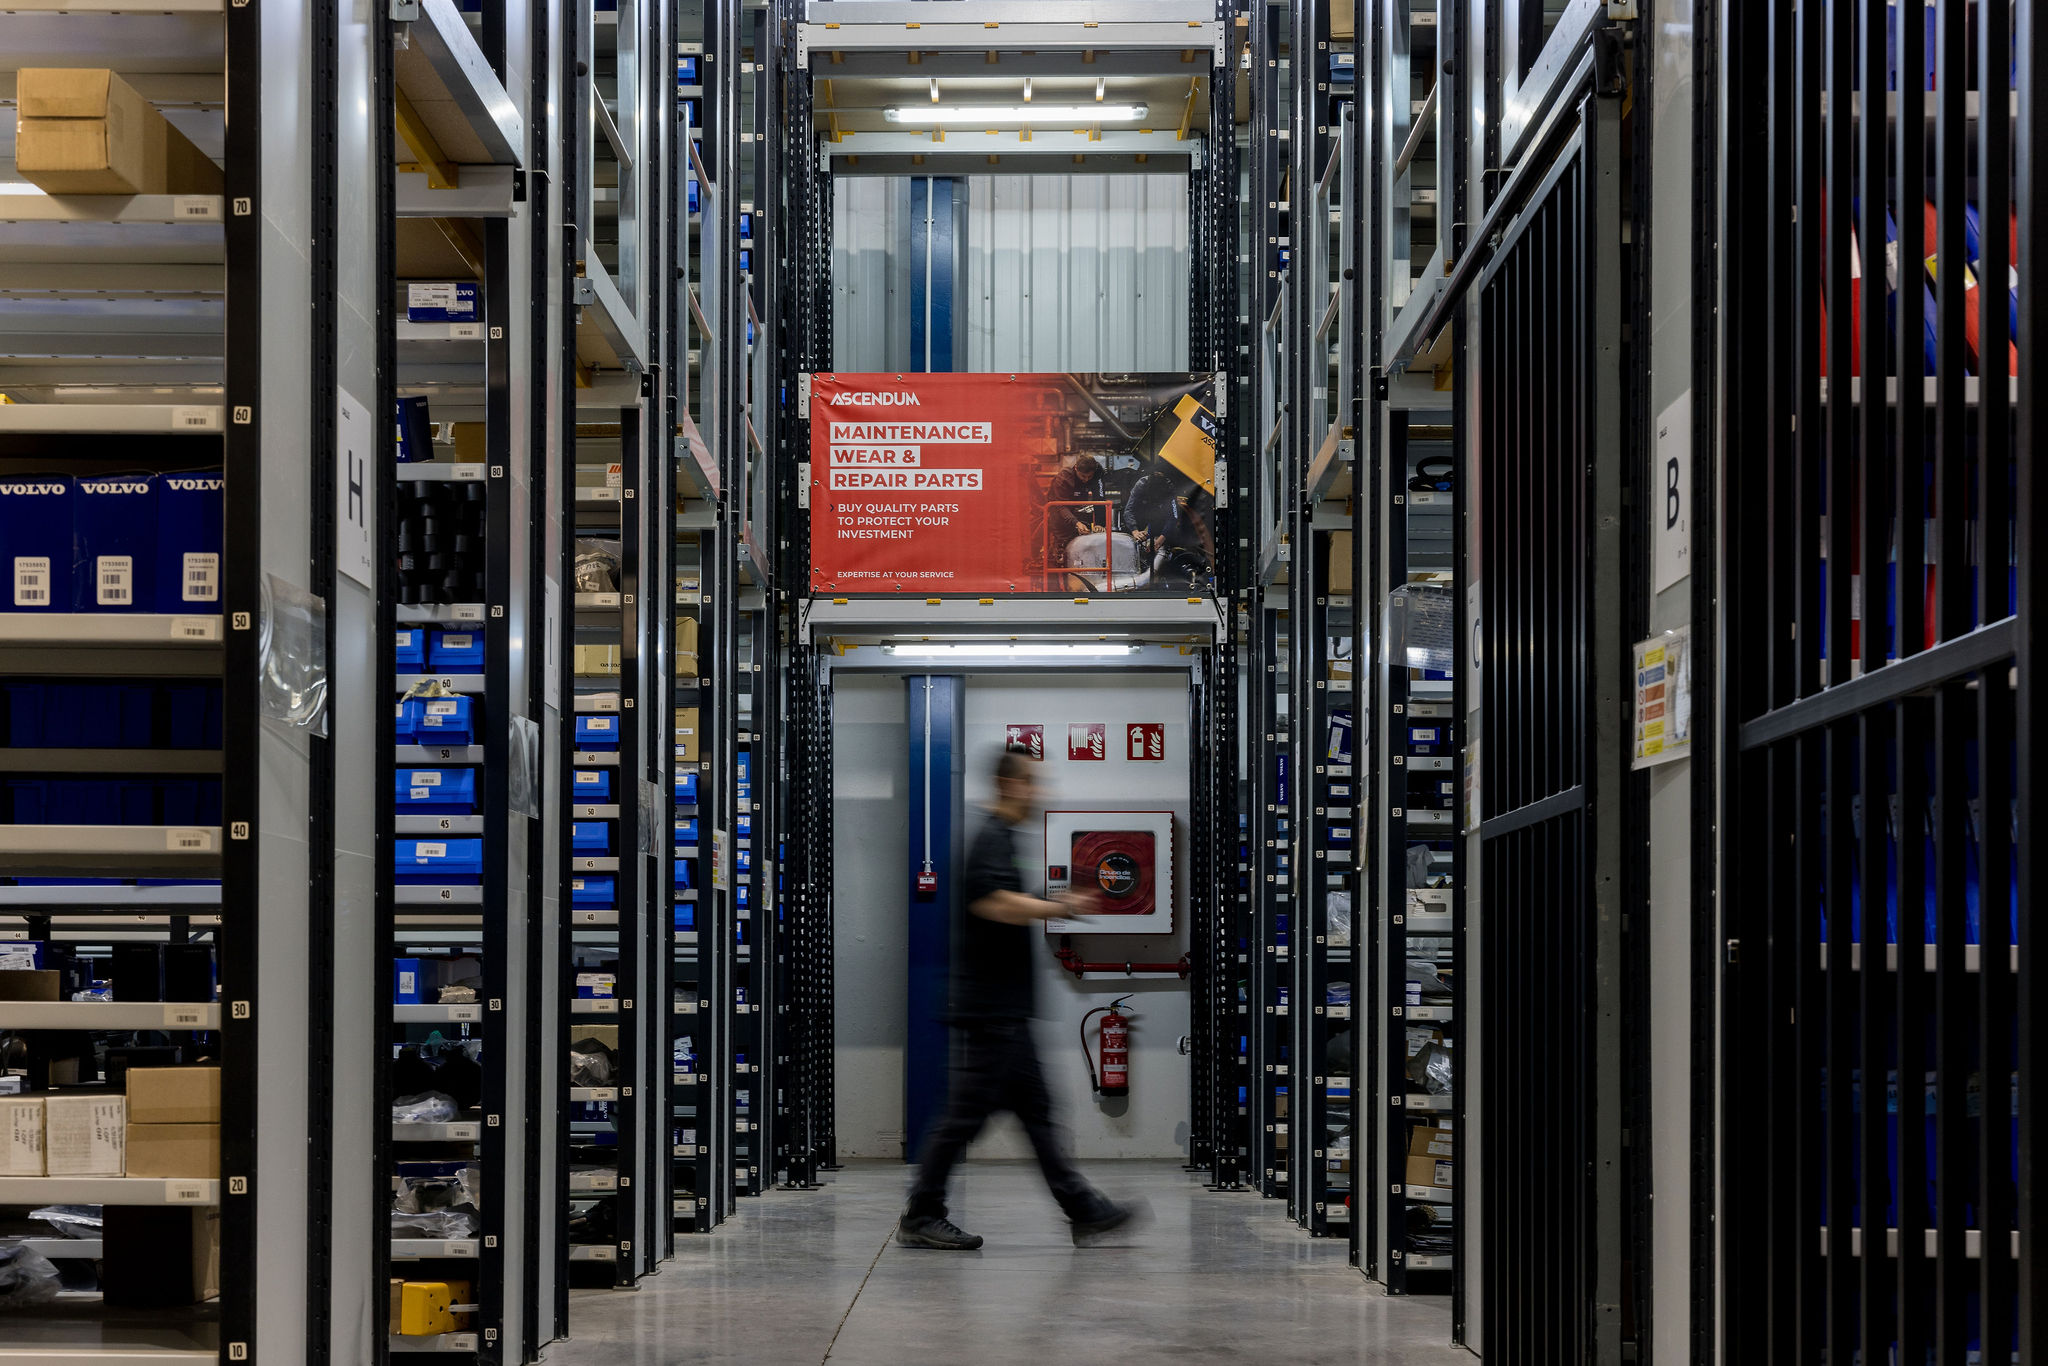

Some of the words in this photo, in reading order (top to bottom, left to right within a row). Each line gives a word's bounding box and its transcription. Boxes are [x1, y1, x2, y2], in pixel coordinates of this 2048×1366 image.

[236, 200, 248, 213] 70
[491, 328, 500, 338] 90
[830, 392, 920, 406] ASCENDUM
[235, 408, 248, 421] 60
[834, 425, 989, 443] MAINTENANCE,
[834, 449, 898, 464] WEAR
[902, 449, 916, 464] &
[492, 467, 501, 476] 80
[166, 480, 225, 490] VOLV
[834, 473, 908, 488] REPAIR
[914, 473, 979, 488] PARTS
[0, 484, 66, 495] VOLVO
[81, 483, 149, 494] VOLVO
[348, 449, 363, 528] H
[1666, 456, 1680, 532] B
[837, 503, 862, 513] BUY
[865, 503, 918, 514] QUALITY
[920, 503, 959, 513] PARTS
[837, 516, 854, 526] TO
[856, 516, 912, 526] PROTECT
[914, 516, 949, 526] YOUR
[837, 529, 914, 539] INVESTMENT
[837, 571, 881, 579] EXPERTISE
[882, 571, 893, 579] AT
[894, 571, 918, 579] YOUR
[920, 571, 954, 579] SERVICE
[492, 607, 501, 616] 70
[235, 614, 247, 628] 50
[442, 679, 451, 688] 60
[441, 749, 450, 758] 50
[440, 819, 449, 828] 45
[233, 824, 246, 837] 40
[441, 890, 450, 899] 40
[234, 1003, 246, 1016] 30
[491, 1000, 499, 1009] 30
[489, 1116, 498, 1125] 20
[232, 1179, 244, 1192] 20
[487, 1237, 495, 1246] 10
[486, 1329, 496, 1339] 00
[232, 1344, 243, 1358] 10
